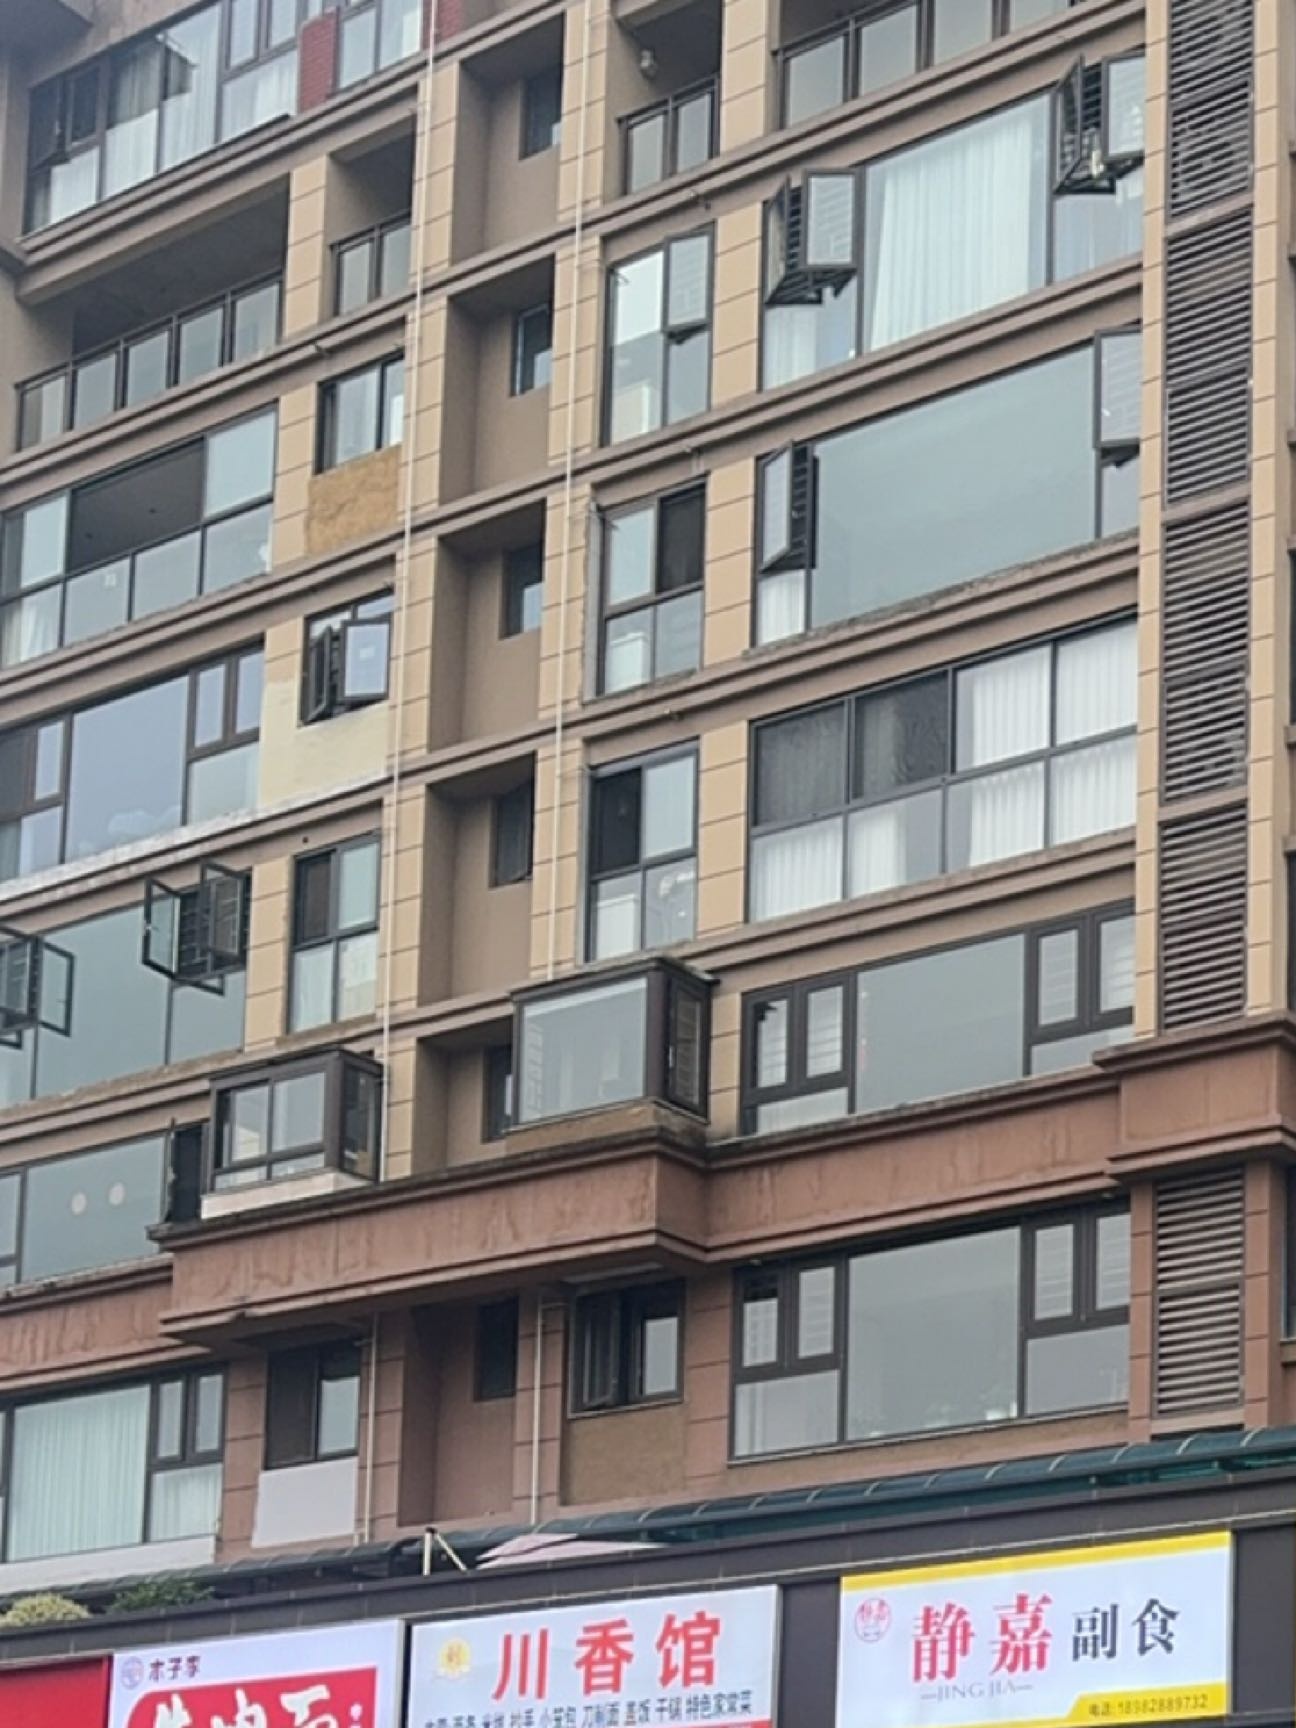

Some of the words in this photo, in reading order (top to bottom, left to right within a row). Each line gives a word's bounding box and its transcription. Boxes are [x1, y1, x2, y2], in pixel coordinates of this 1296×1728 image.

[492, 1611, 722, 1700] 川香馆
[1072, 1598, 1180, 1661] 副食
